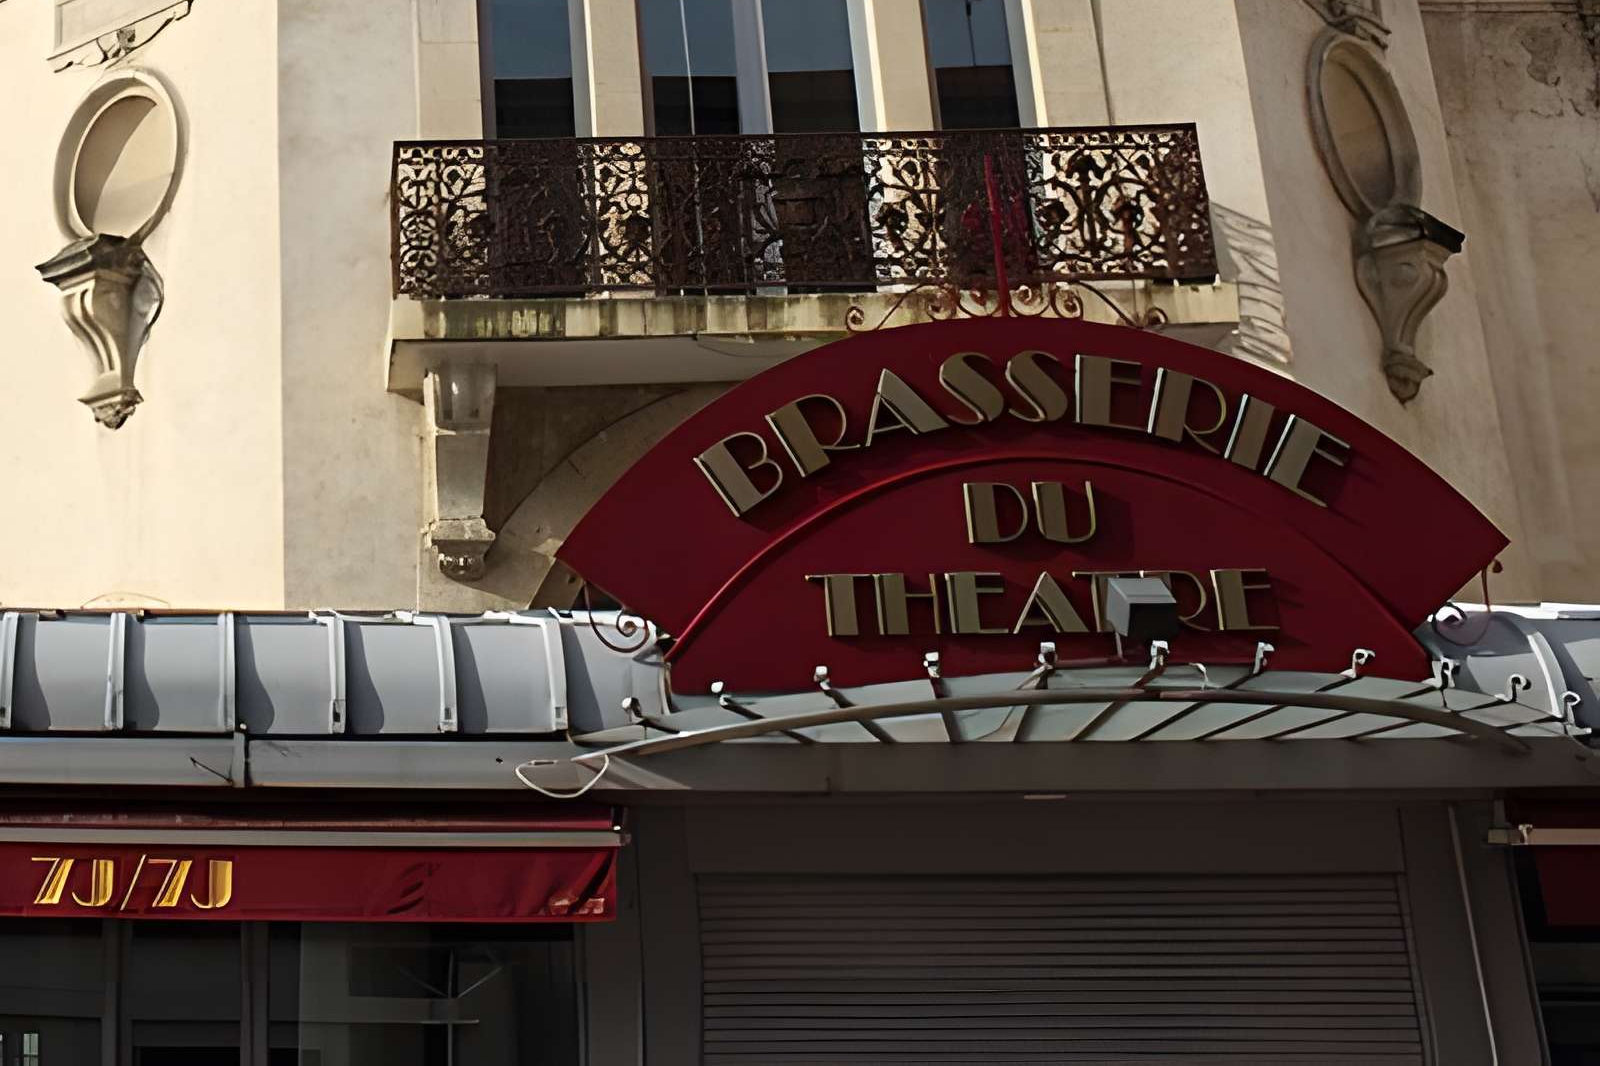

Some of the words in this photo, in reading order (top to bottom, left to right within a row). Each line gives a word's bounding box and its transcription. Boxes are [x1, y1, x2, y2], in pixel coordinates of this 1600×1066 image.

[693, 350, 1352, 517] BRASSERIE
[963, 480, 1096, 545] DU
[31, 854, 233, 910] 7J/7J
